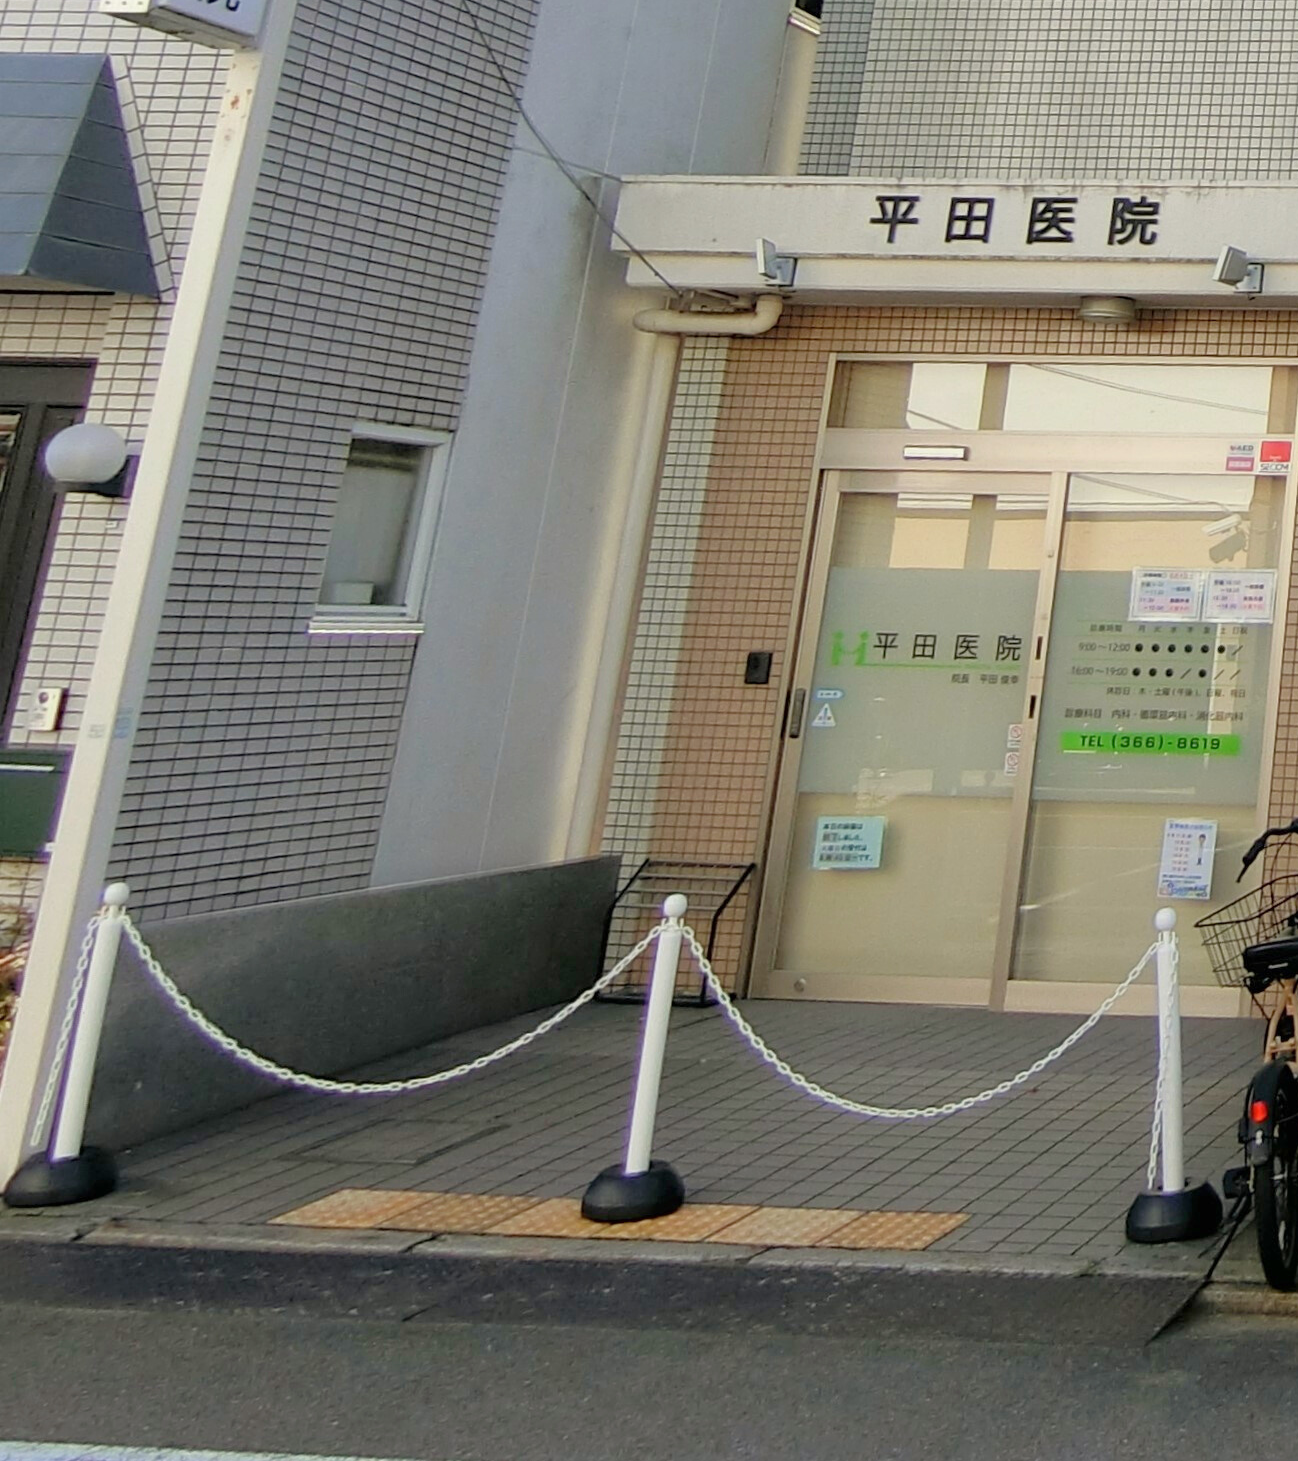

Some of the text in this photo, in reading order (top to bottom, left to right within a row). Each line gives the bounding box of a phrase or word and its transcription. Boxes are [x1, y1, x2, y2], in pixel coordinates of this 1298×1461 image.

[870, 194, 1161, 245] 平田医院
[873, 632, 1022, 662] 平田医院
[1080, 735, 1102, 747] TEL
